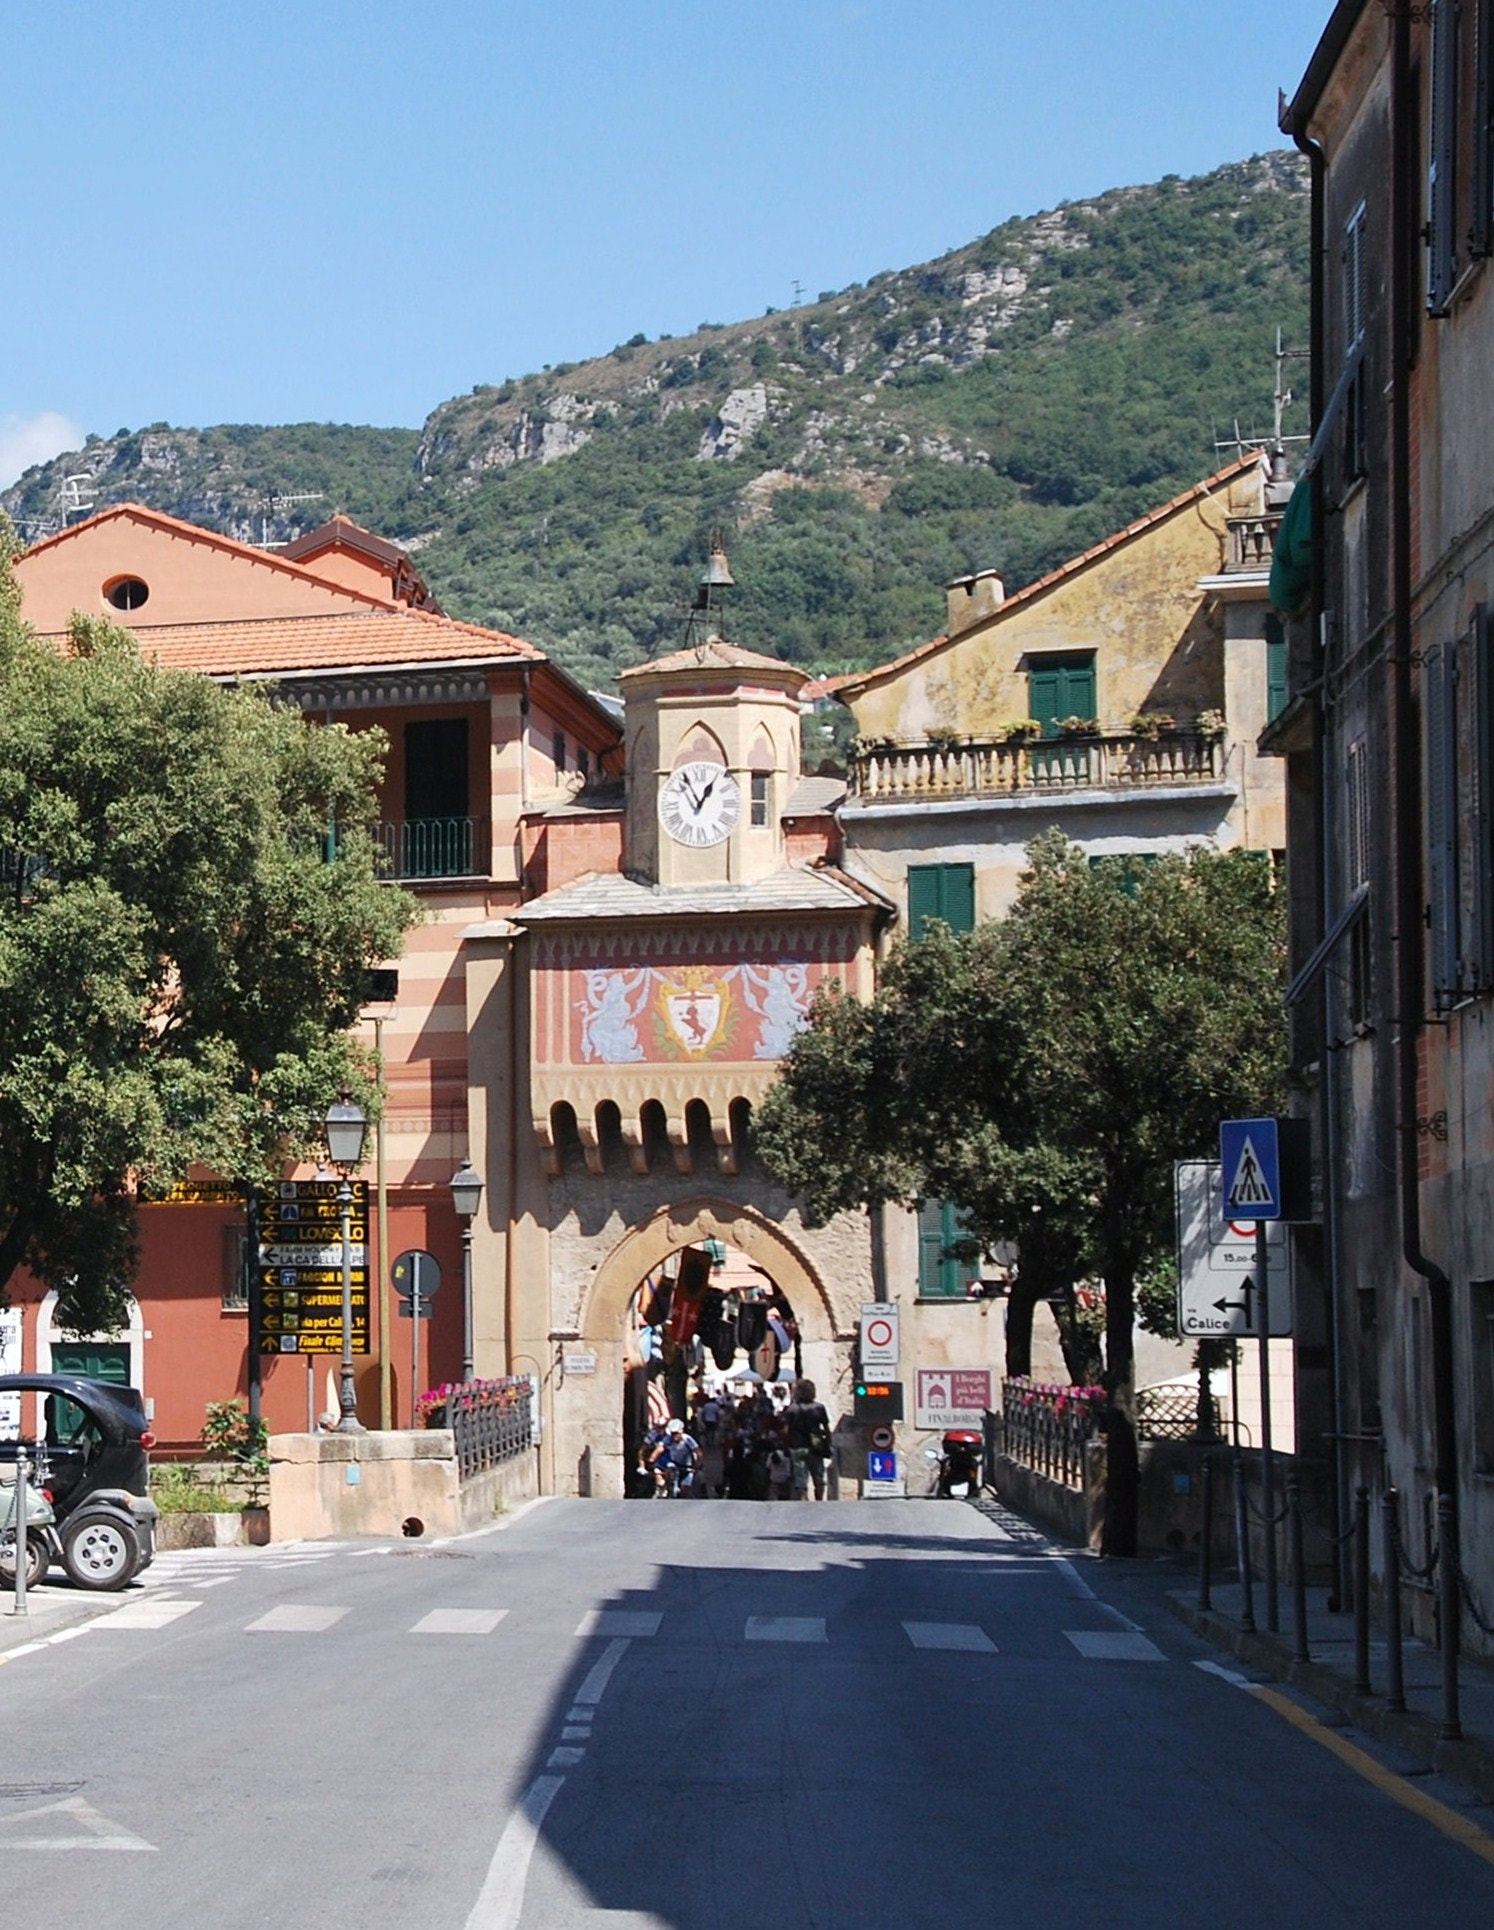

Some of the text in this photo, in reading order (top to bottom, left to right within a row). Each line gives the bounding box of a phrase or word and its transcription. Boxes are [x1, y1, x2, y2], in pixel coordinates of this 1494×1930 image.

[298, 1183, 337, 1196] GALLO
[302, 1294, 366, 1306] SUPERMEATO
[1187, 1317, 1230, 1330] Calice
[961, 1374, 986, 1384] Borghi
